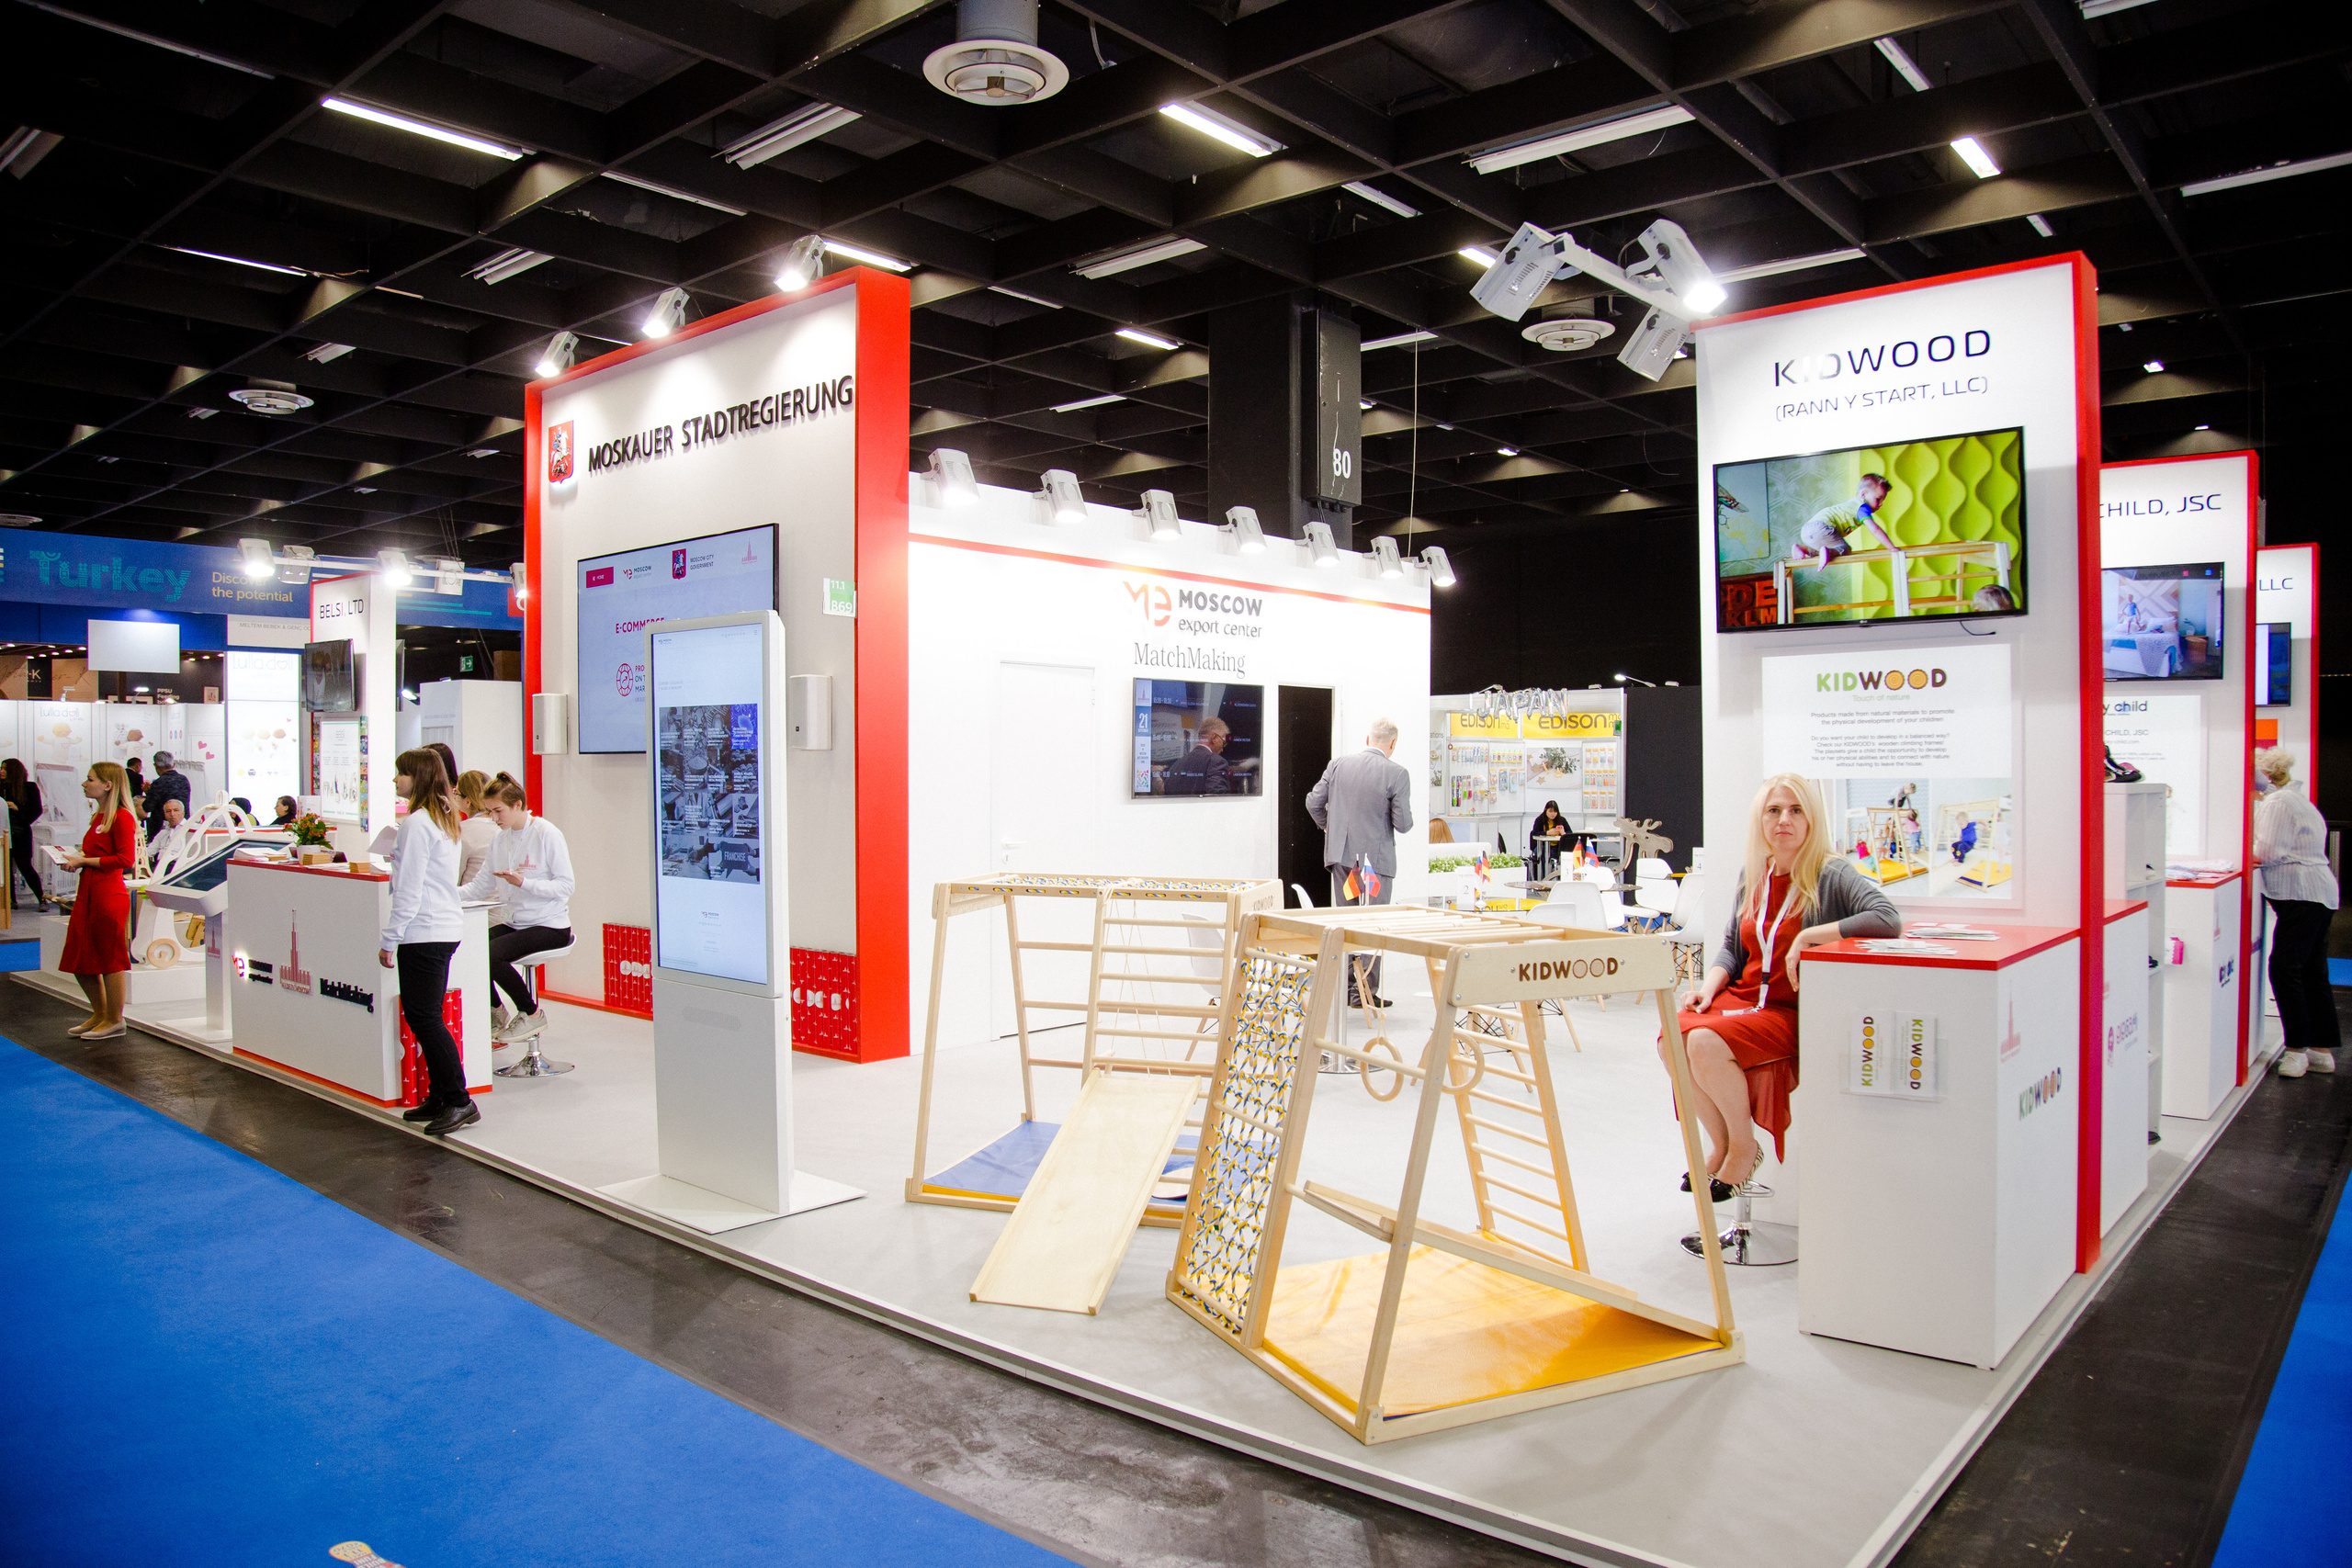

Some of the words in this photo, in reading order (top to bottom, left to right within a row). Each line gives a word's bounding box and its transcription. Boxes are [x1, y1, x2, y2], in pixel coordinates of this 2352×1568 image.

[1862, 384, 1936, 407] START,
[1942, 376, 1988, 396] LLC)
[588, 425, 673, 472] MOSKAUER
[681, 375, 854, 447] STADTREGIERUNG
[1333, 448, 1351, 479] 80
[2177, 493, 2222, 513] JSC
[29, 549, 191, 603] Turkey
[212, 571, 268, 587] Discover
[831, 580, 845, 591] 11.1
[2258, 577, 2294, 592] LLC
[212, 586, 234, 599] the
[236, 589, 294, 603] potential
[1179, 589, 1262, 616] MOSCOW
[348, 599, 364, 615] LTD
[831, 600, 853, 614] B69
[1178, 618, 1219, 636] export
[1224, 623, 1262, 637] center
[1134, 642, 1246, 679] MatchMaking
[1816, 668, 1948, 692] KIDWOOD
[1476, 687, 1567, 724] JAPAN
[2114, 701, 2148, 712] child
[1139, 713, 1148, 728] 21
[1539, 714, 1607, 729] EDISON
[724, 851, 746, 862] FRANCHISE
[1519, 957, 1619, 982] KIDWOOD
[1861, 1016, 1875, 1087] KIDWOOD
[1910, 1019, 1924, 1090] KIDWOOD
[2019, 1066, 2062, 1122] KIDWOOD
